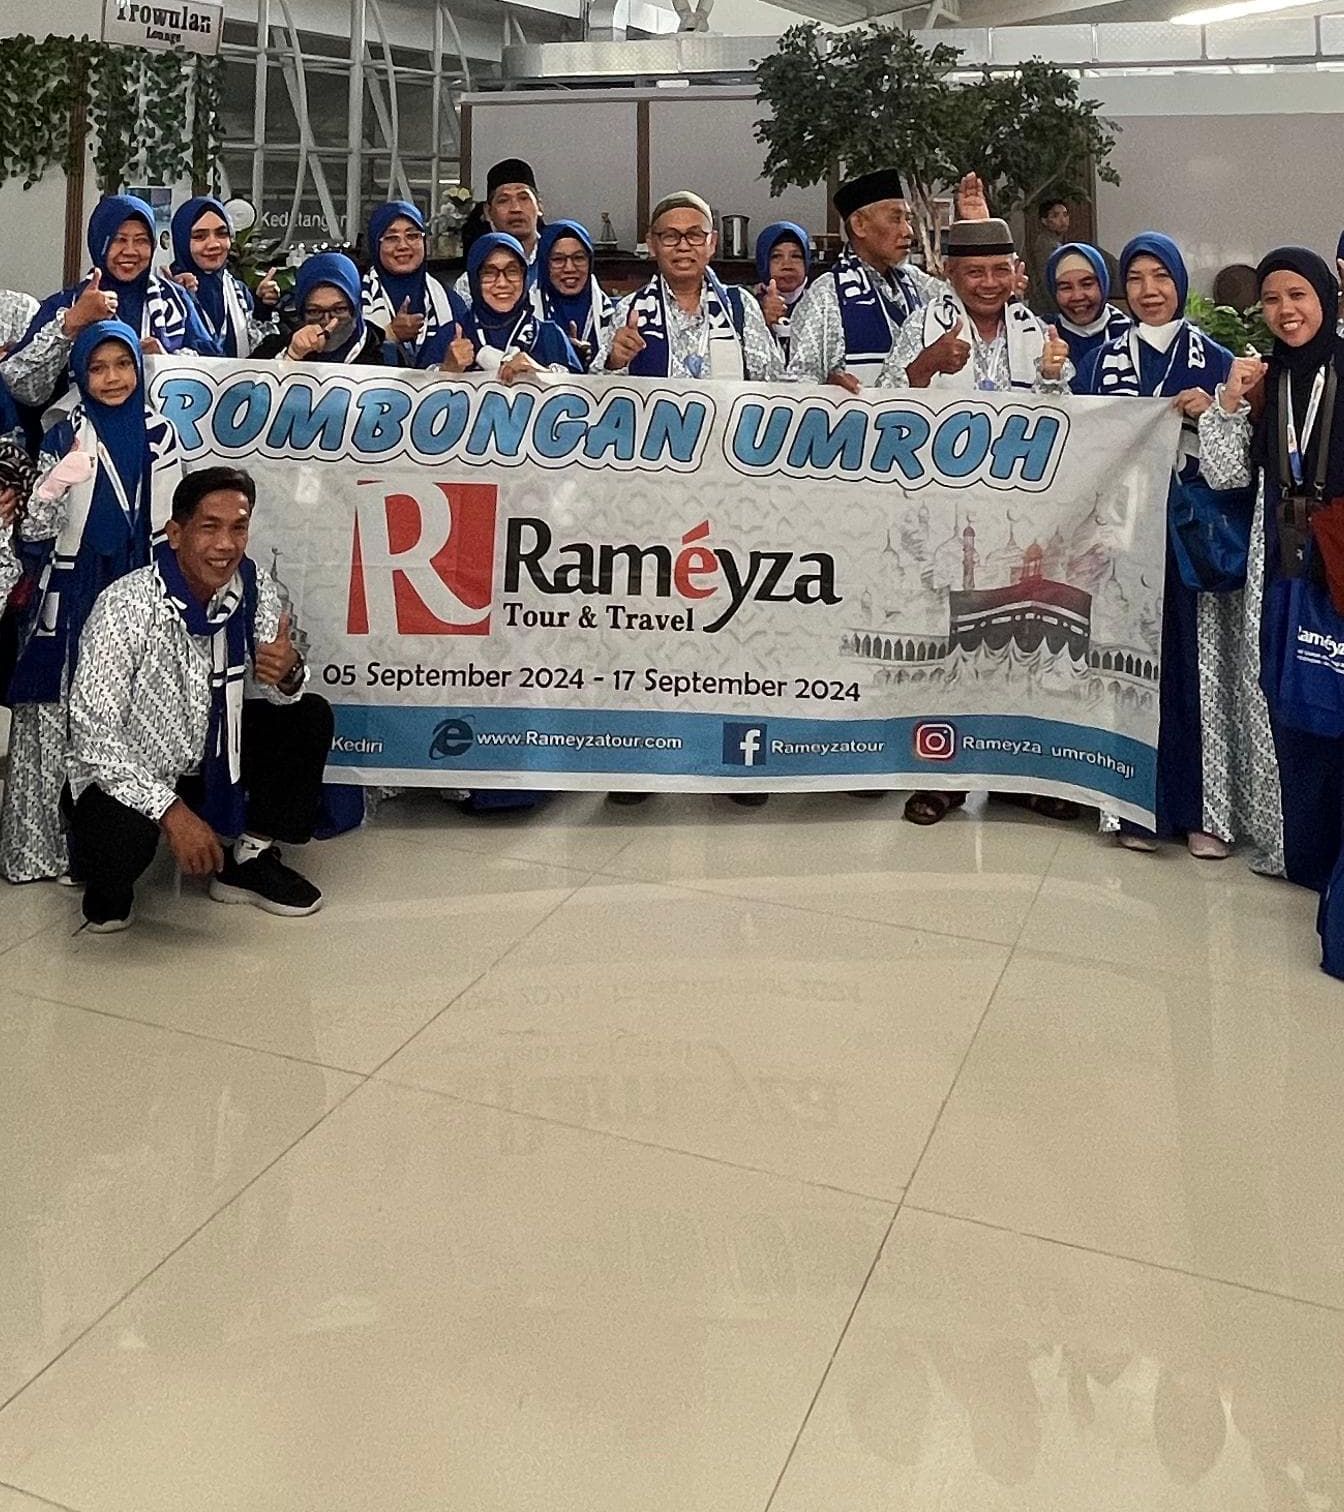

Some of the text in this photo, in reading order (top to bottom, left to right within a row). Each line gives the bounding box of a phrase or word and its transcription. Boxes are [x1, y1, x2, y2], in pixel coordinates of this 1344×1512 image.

[156, 376, 1061, 482] ROMBONGAN UMROH
[353, 480, 496, 635] R
[503, 517, 843, 633] Raméyza
[503, 601, 695, 632] Tour & Travel
[322, 664, 356, 686] 05
[366, 661, 512, 691] September
[519, 667, 585, 689] 2024
[613, 670, 636, 691] 17
[644, 668, 788, 697] September
[794, 678, 861, 702] 2024
[331, 735, 384, 754] Kediri
[477, 729, 683, 751] www.Rameyzatour.com
[771, 739, 885, 756] Rameyzatour
